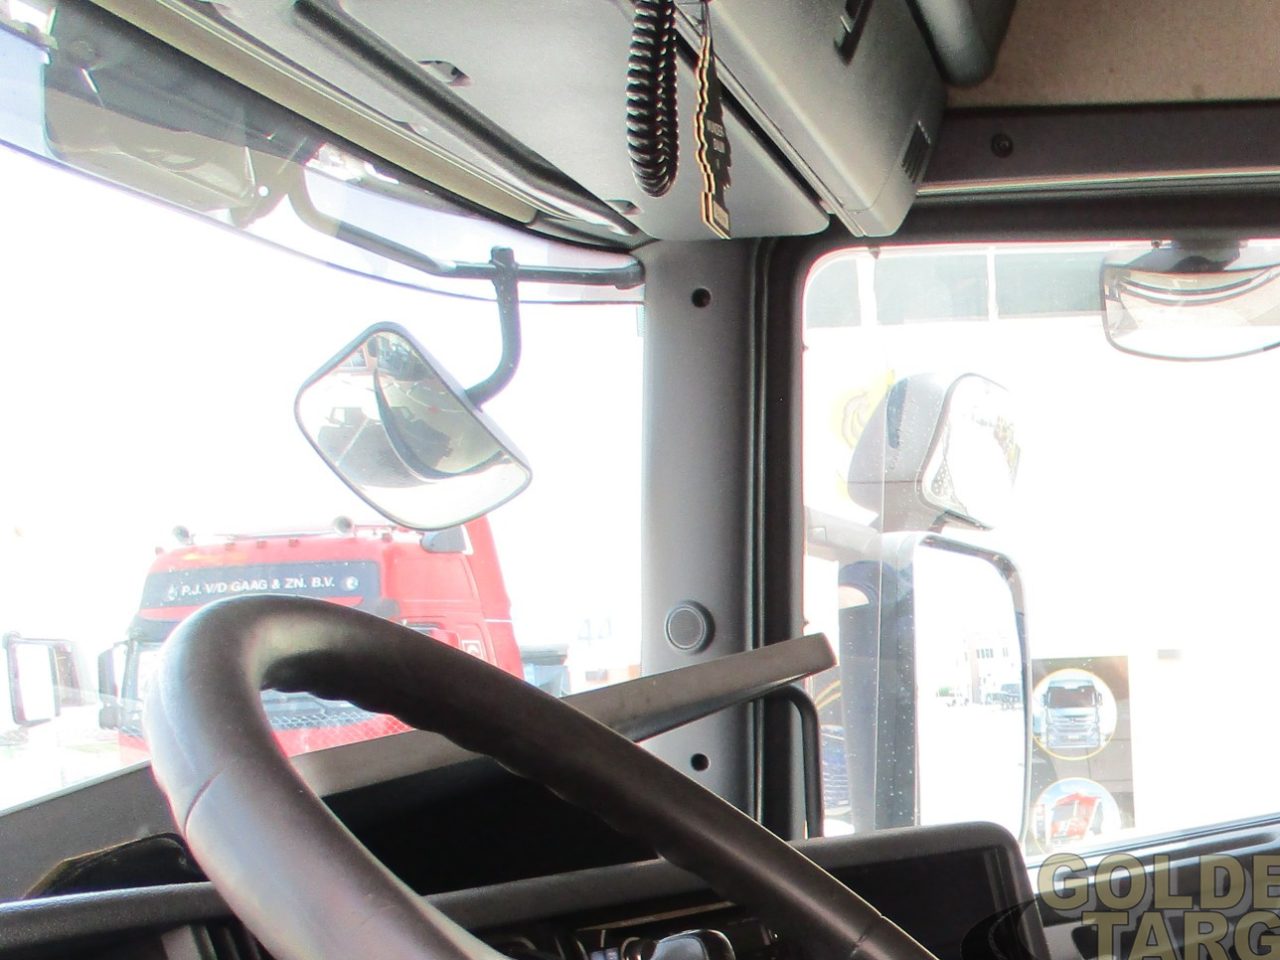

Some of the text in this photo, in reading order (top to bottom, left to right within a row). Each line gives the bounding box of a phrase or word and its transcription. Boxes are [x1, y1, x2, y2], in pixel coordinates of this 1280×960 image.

[181, 576, 336, 597] P.J. V/D GAAG & ZN. B.V.
